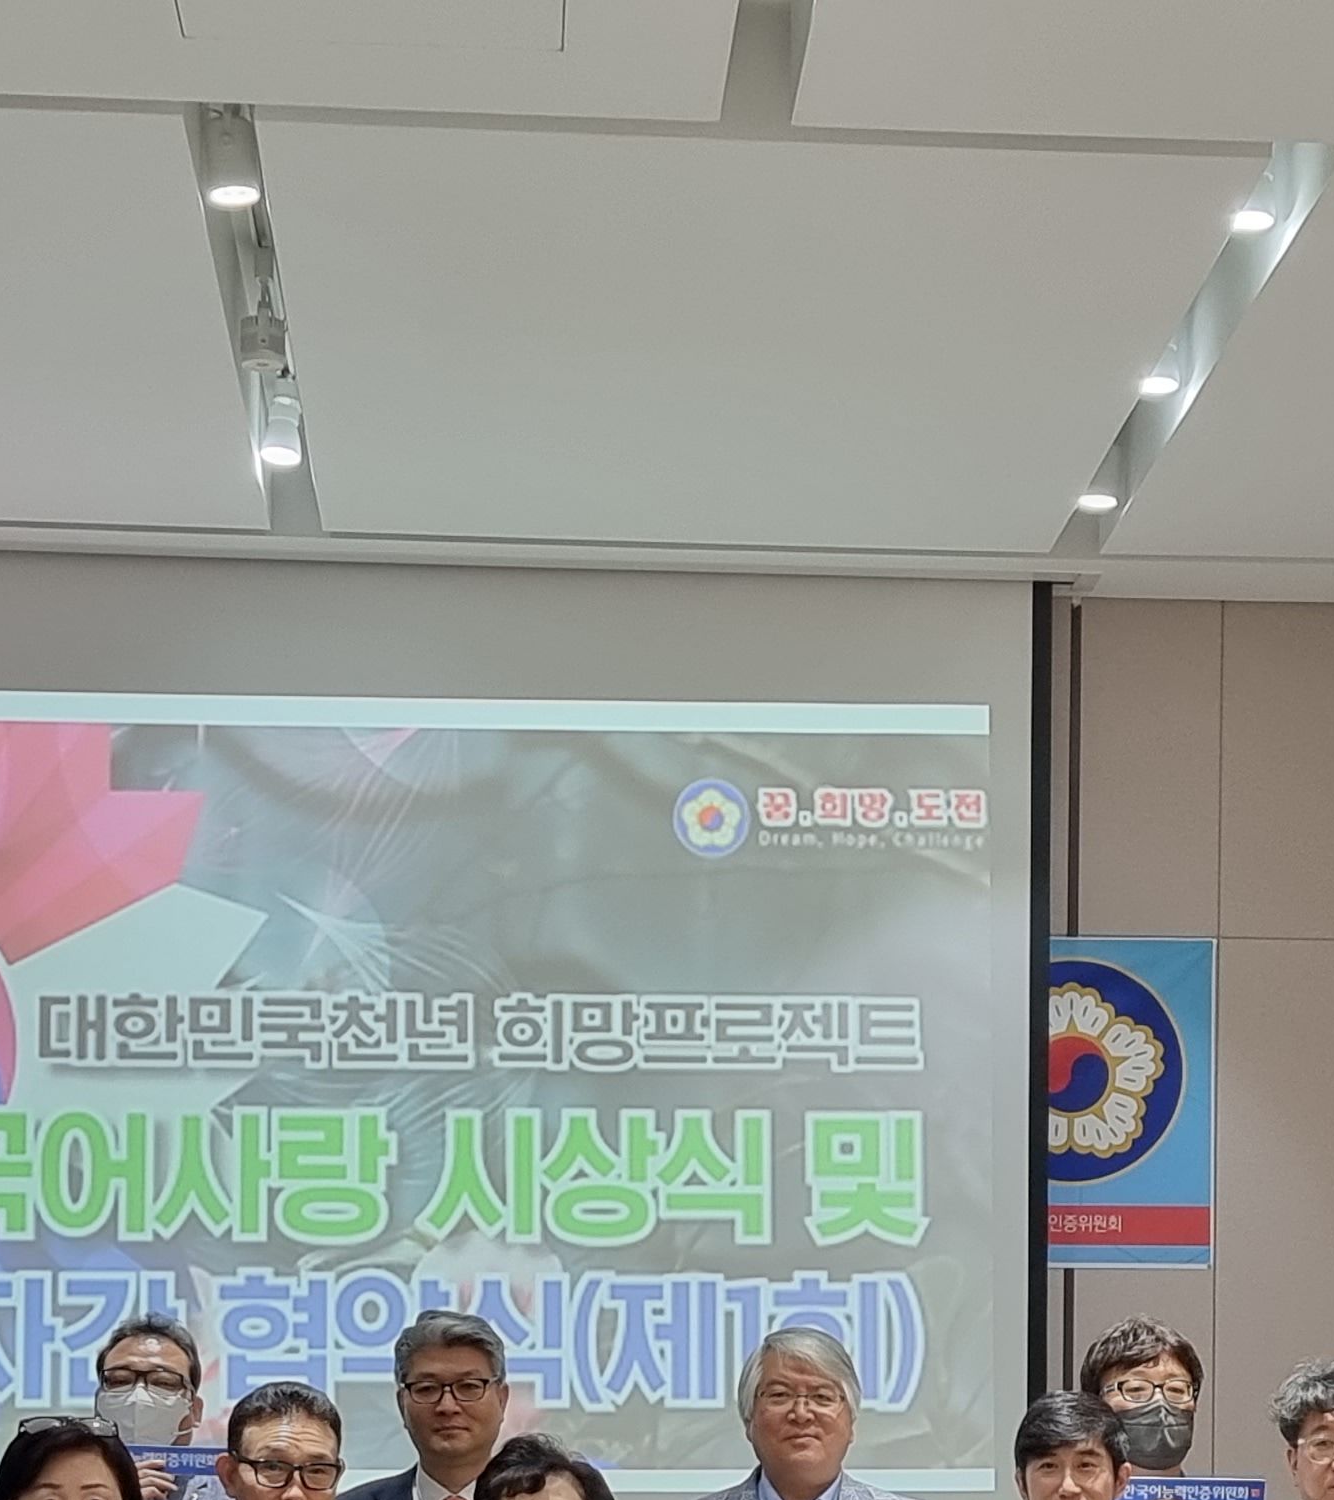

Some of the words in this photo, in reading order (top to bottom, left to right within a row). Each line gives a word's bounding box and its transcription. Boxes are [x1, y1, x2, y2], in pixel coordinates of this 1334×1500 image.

[37, 992, 474, 1070] 대한민국천년
[493, 994, 924, 1072] 희망프로젝트
[423, 1108, 772, 1246] 시상식
[804, 1111, 930, 1248] 및
